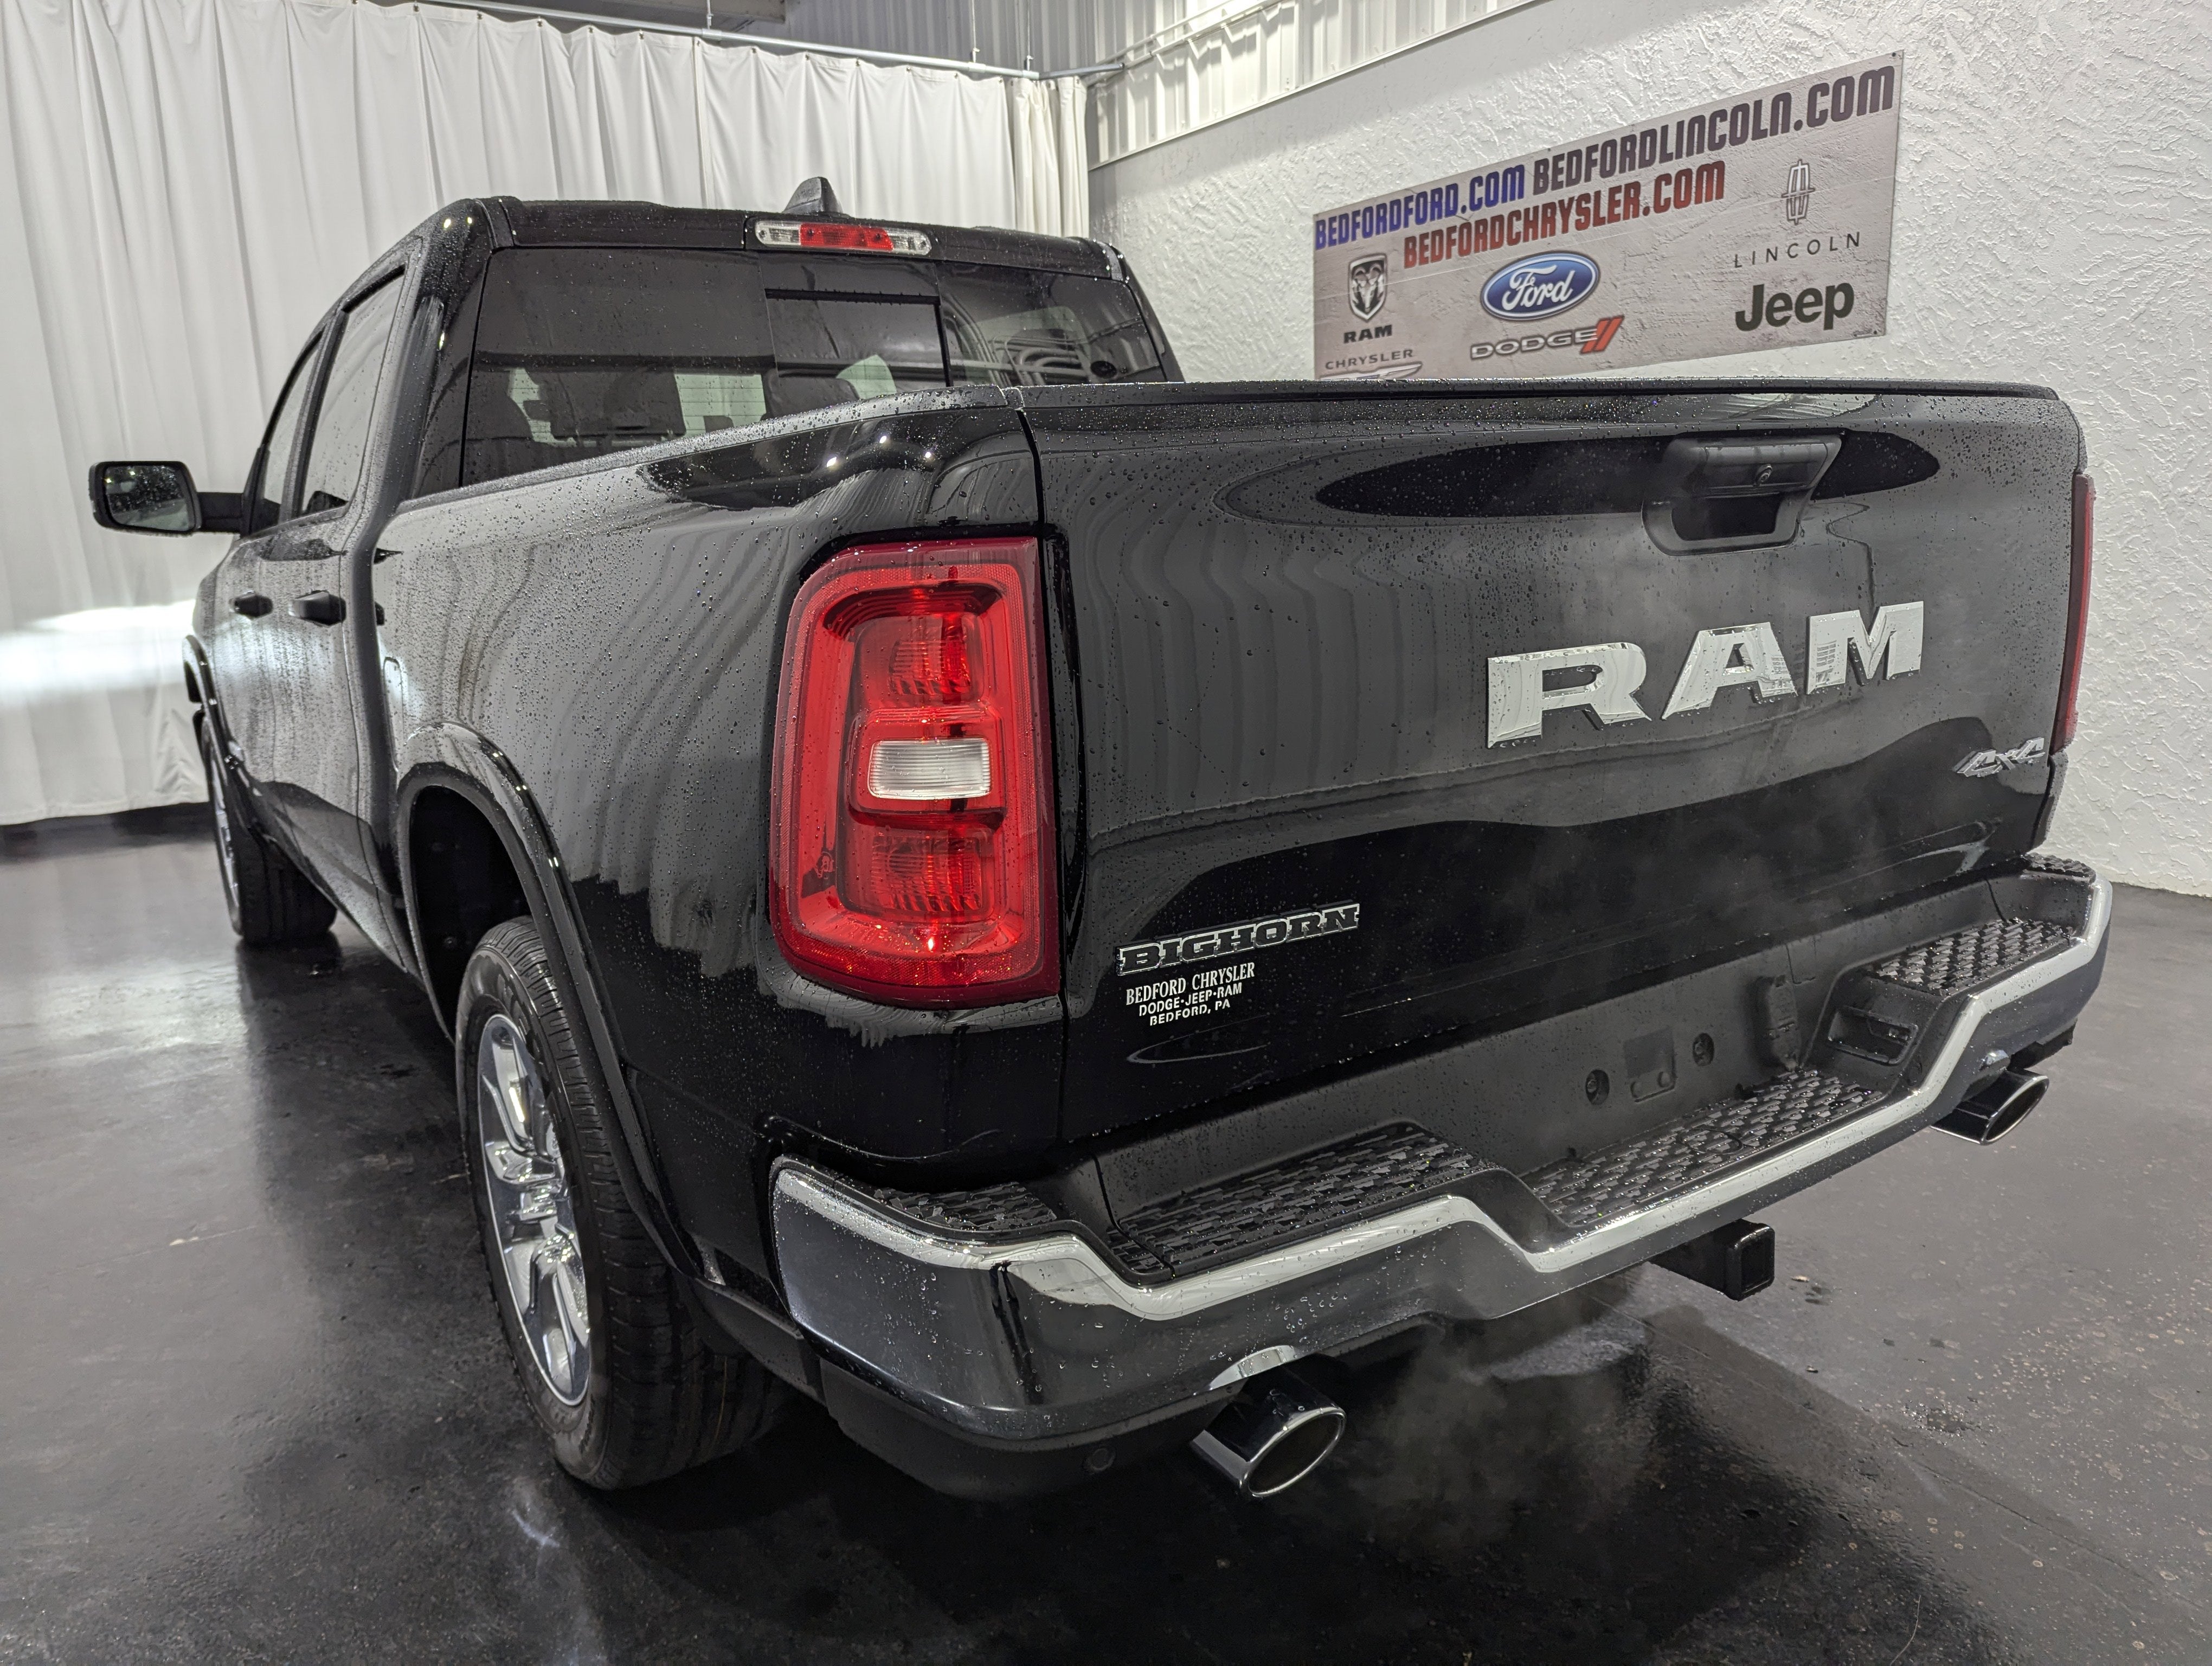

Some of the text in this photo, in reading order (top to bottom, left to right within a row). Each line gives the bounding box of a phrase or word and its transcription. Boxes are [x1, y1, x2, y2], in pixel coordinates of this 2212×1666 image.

[1315, 66, 1895, 251] BEDFORDFORD.COM BEDFORDLINCOLN.COM
[1404, 161, 1725, 269] BEDFORDCHRYSLER.COM
[1735, 232, 1860, 268] LINCOLN
[1501, 264, 1576, 311] Ford
[1735, 282, 1854, 332] Jeep
[1343, 324, 1393, 344] RAM
[1470, 327, 1599, 361] DODGE
[1325, 349, 1414, 370] CHRYSLER
[1487, 600, 1924, 749] RAM
[1126, 962, 1256, 1005] BEDFORD CHRYSLER
[1149, 999, 1231, 1026] BEDFORD, PA
